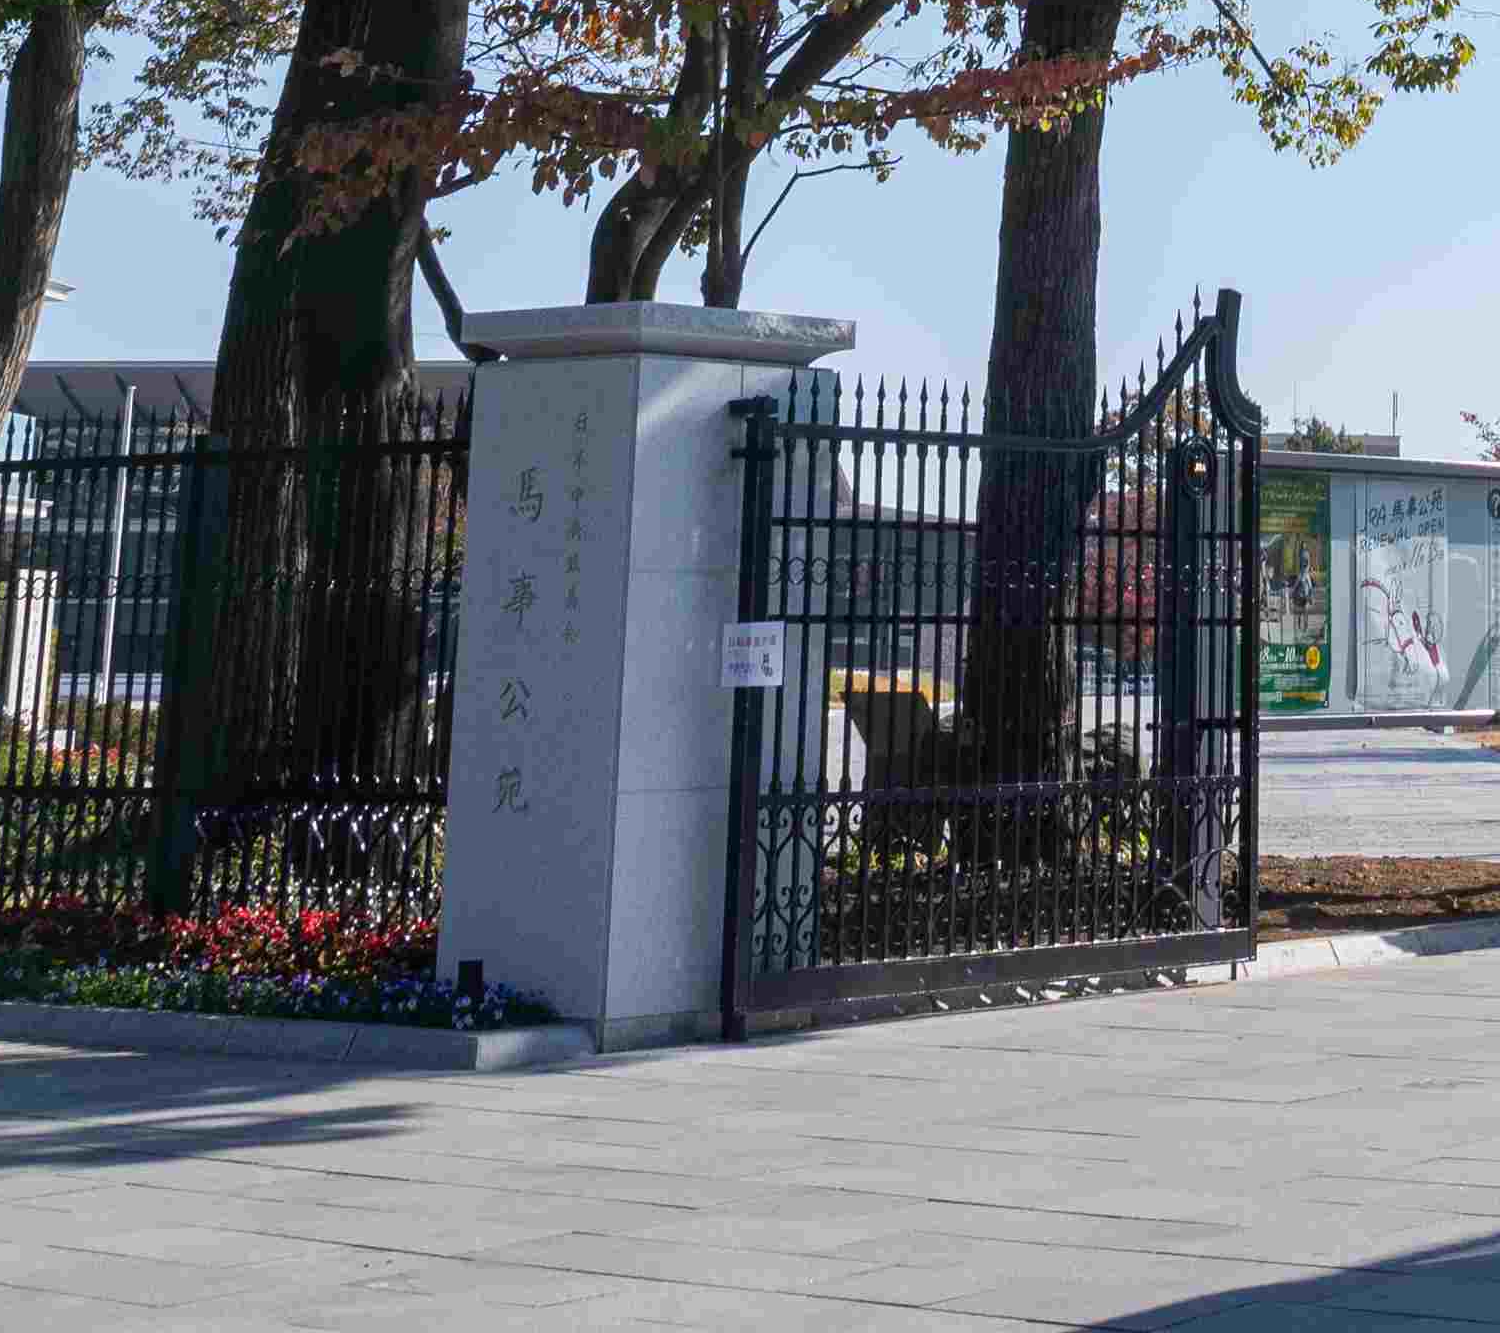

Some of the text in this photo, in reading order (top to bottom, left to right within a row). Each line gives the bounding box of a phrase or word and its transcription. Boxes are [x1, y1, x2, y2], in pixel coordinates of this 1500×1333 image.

[1419, 517, 1444, 538] OPEN
[491, 462, 544, 817] 馬事公苑
